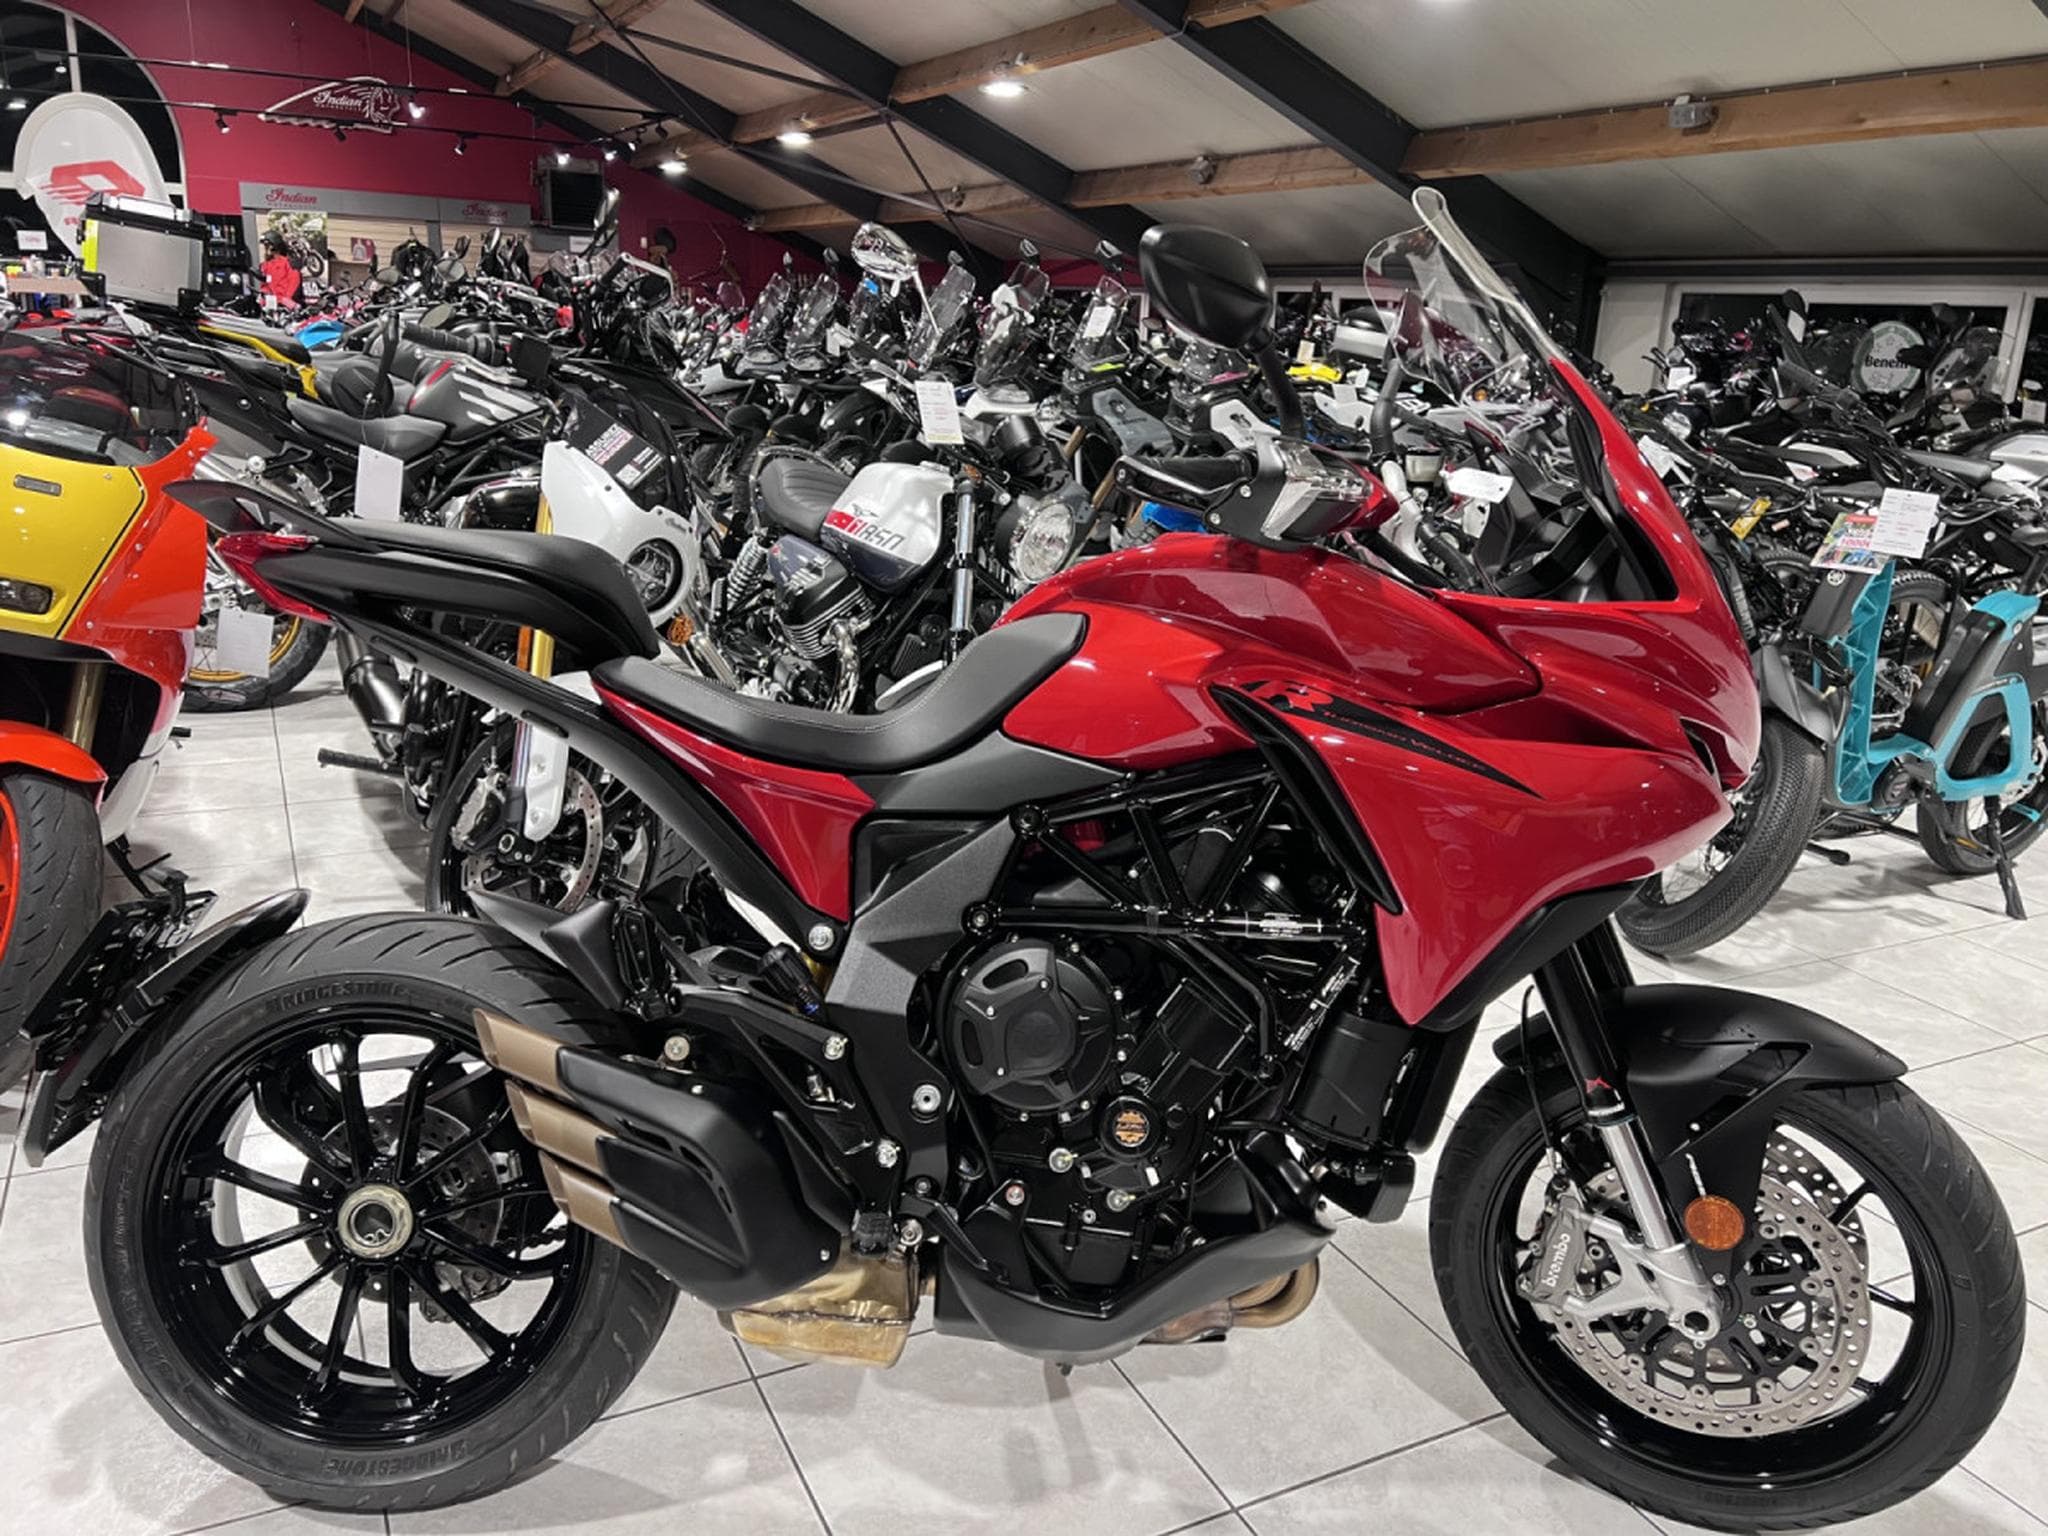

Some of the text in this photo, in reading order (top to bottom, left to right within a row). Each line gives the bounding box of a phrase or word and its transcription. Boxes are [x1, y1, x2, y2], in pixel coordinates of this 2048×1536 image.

[313, 90, 361, 107] Indian
[266, 188, 317, 204] Indian
[1541, 1232, 1571, 1288] brembo
